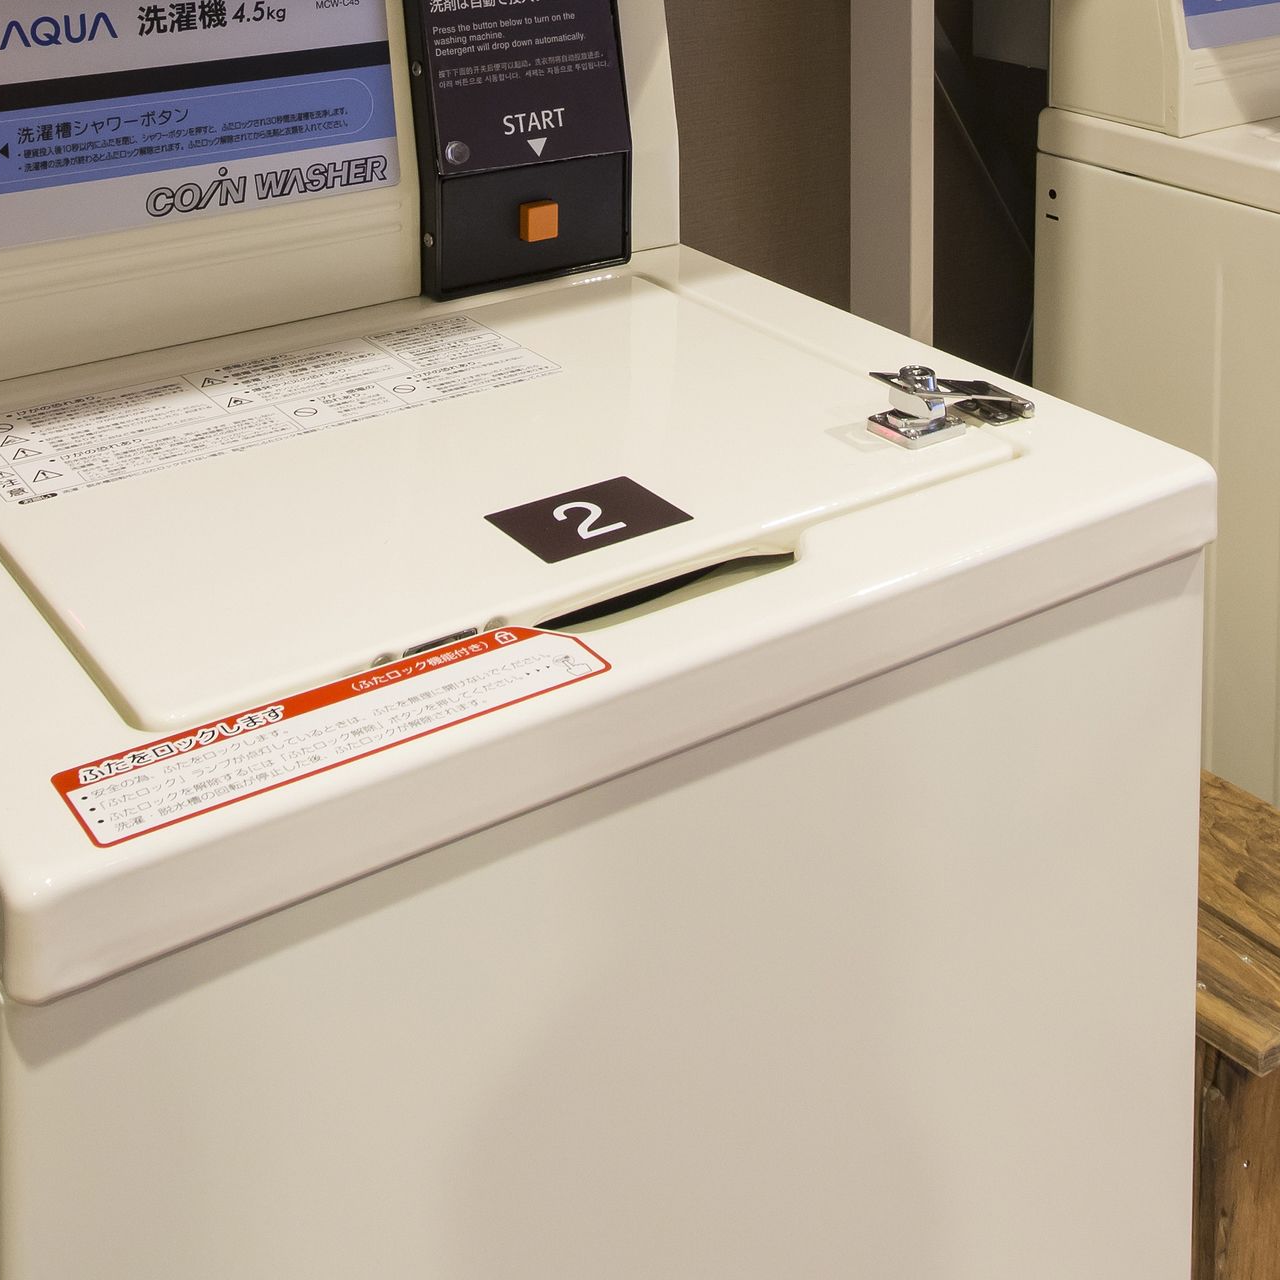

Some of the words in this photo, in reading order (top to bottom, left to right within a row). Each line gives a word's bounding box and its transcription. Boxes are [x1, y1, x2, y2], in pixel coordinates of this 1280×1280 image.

[0, 12, 118, 50] AQUA
[137, 0, 227, 36] 洗濯機
[232, 1, 286, 23] 4.5kg
[17, 108, 189, 145] 洗濯槽シャワーボタン
[503, 108, 565, 135] START
[146, 167, 246, 217] COIN
[254, 156, 387, 199] WASHER
[552, 500, 628, 540] 2
[80, 706, 283, 782] ふたをロックします
